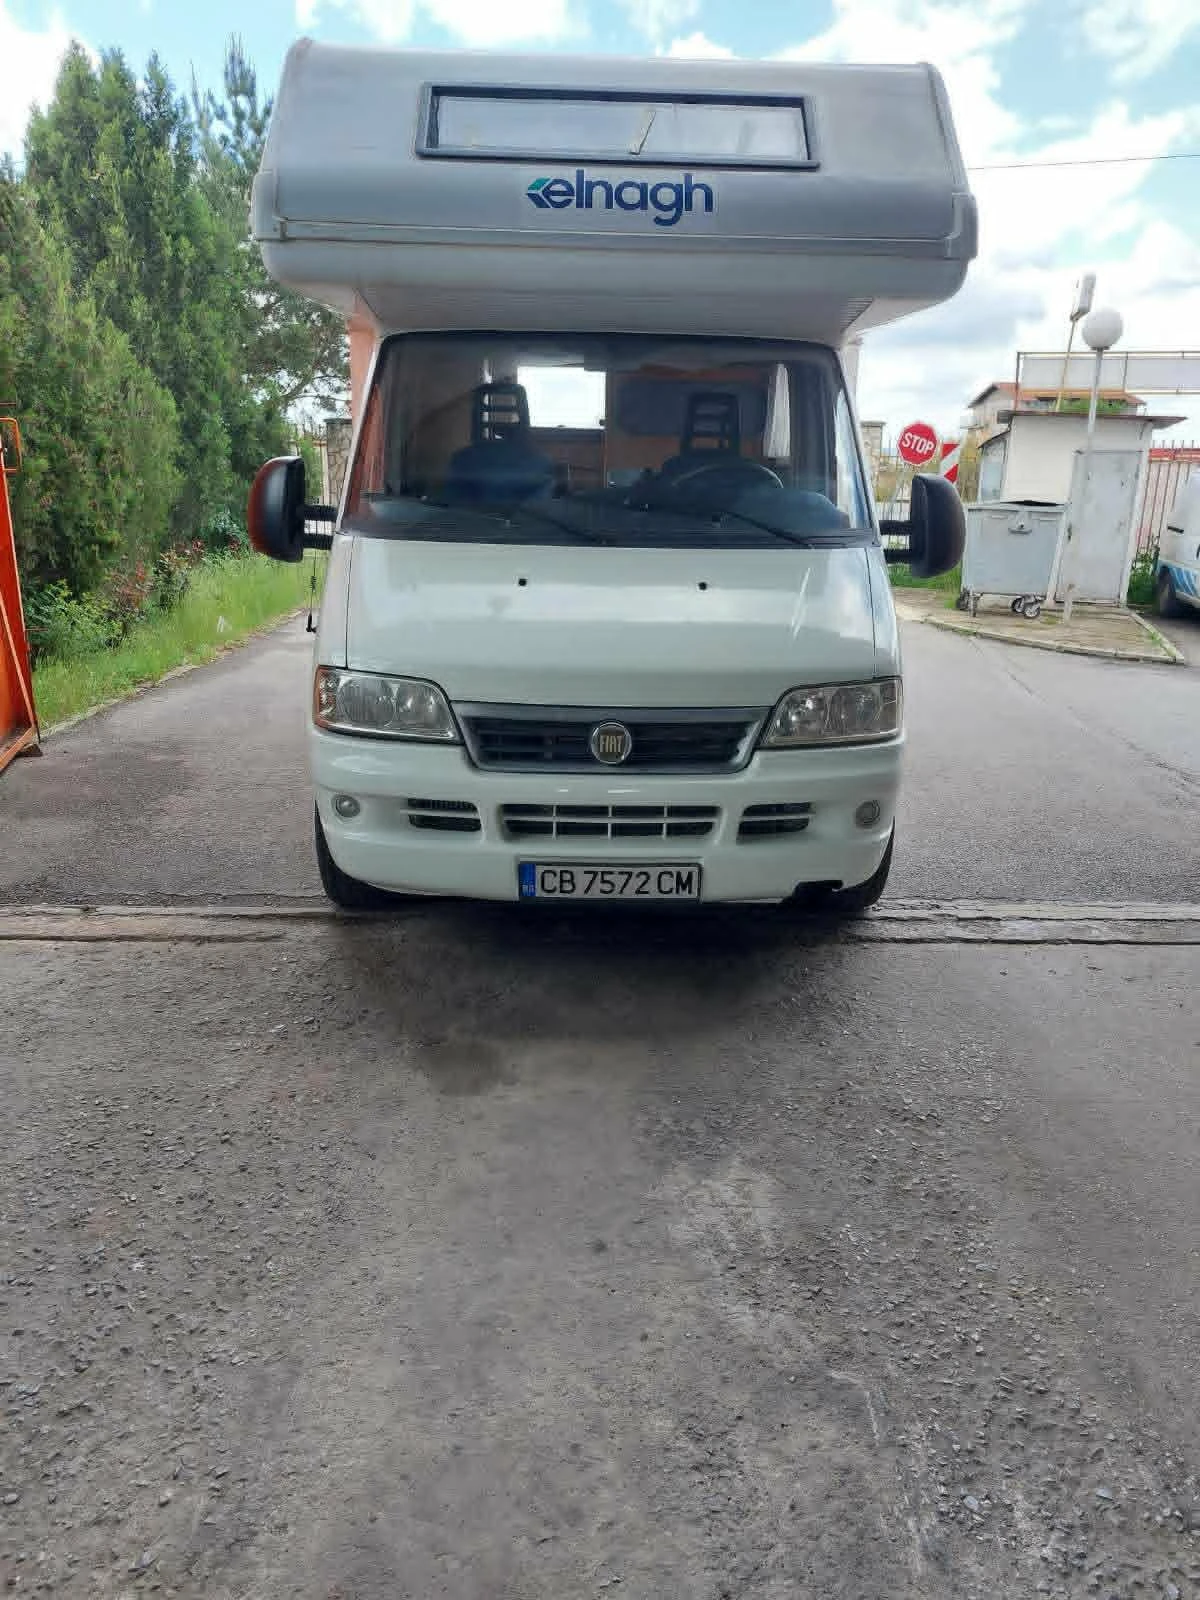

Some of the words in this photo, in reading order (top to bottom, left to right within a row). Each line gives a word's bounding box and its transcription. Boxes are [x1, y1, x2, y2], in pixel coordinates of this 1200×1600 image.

[541, 168, 713, 227] elnagh
[901, 431, 935, 455] STOP
[540, 869, 576, 895] CB
[583, 870, 650, 895] 7572
[656, 871, 693, 895] CM
